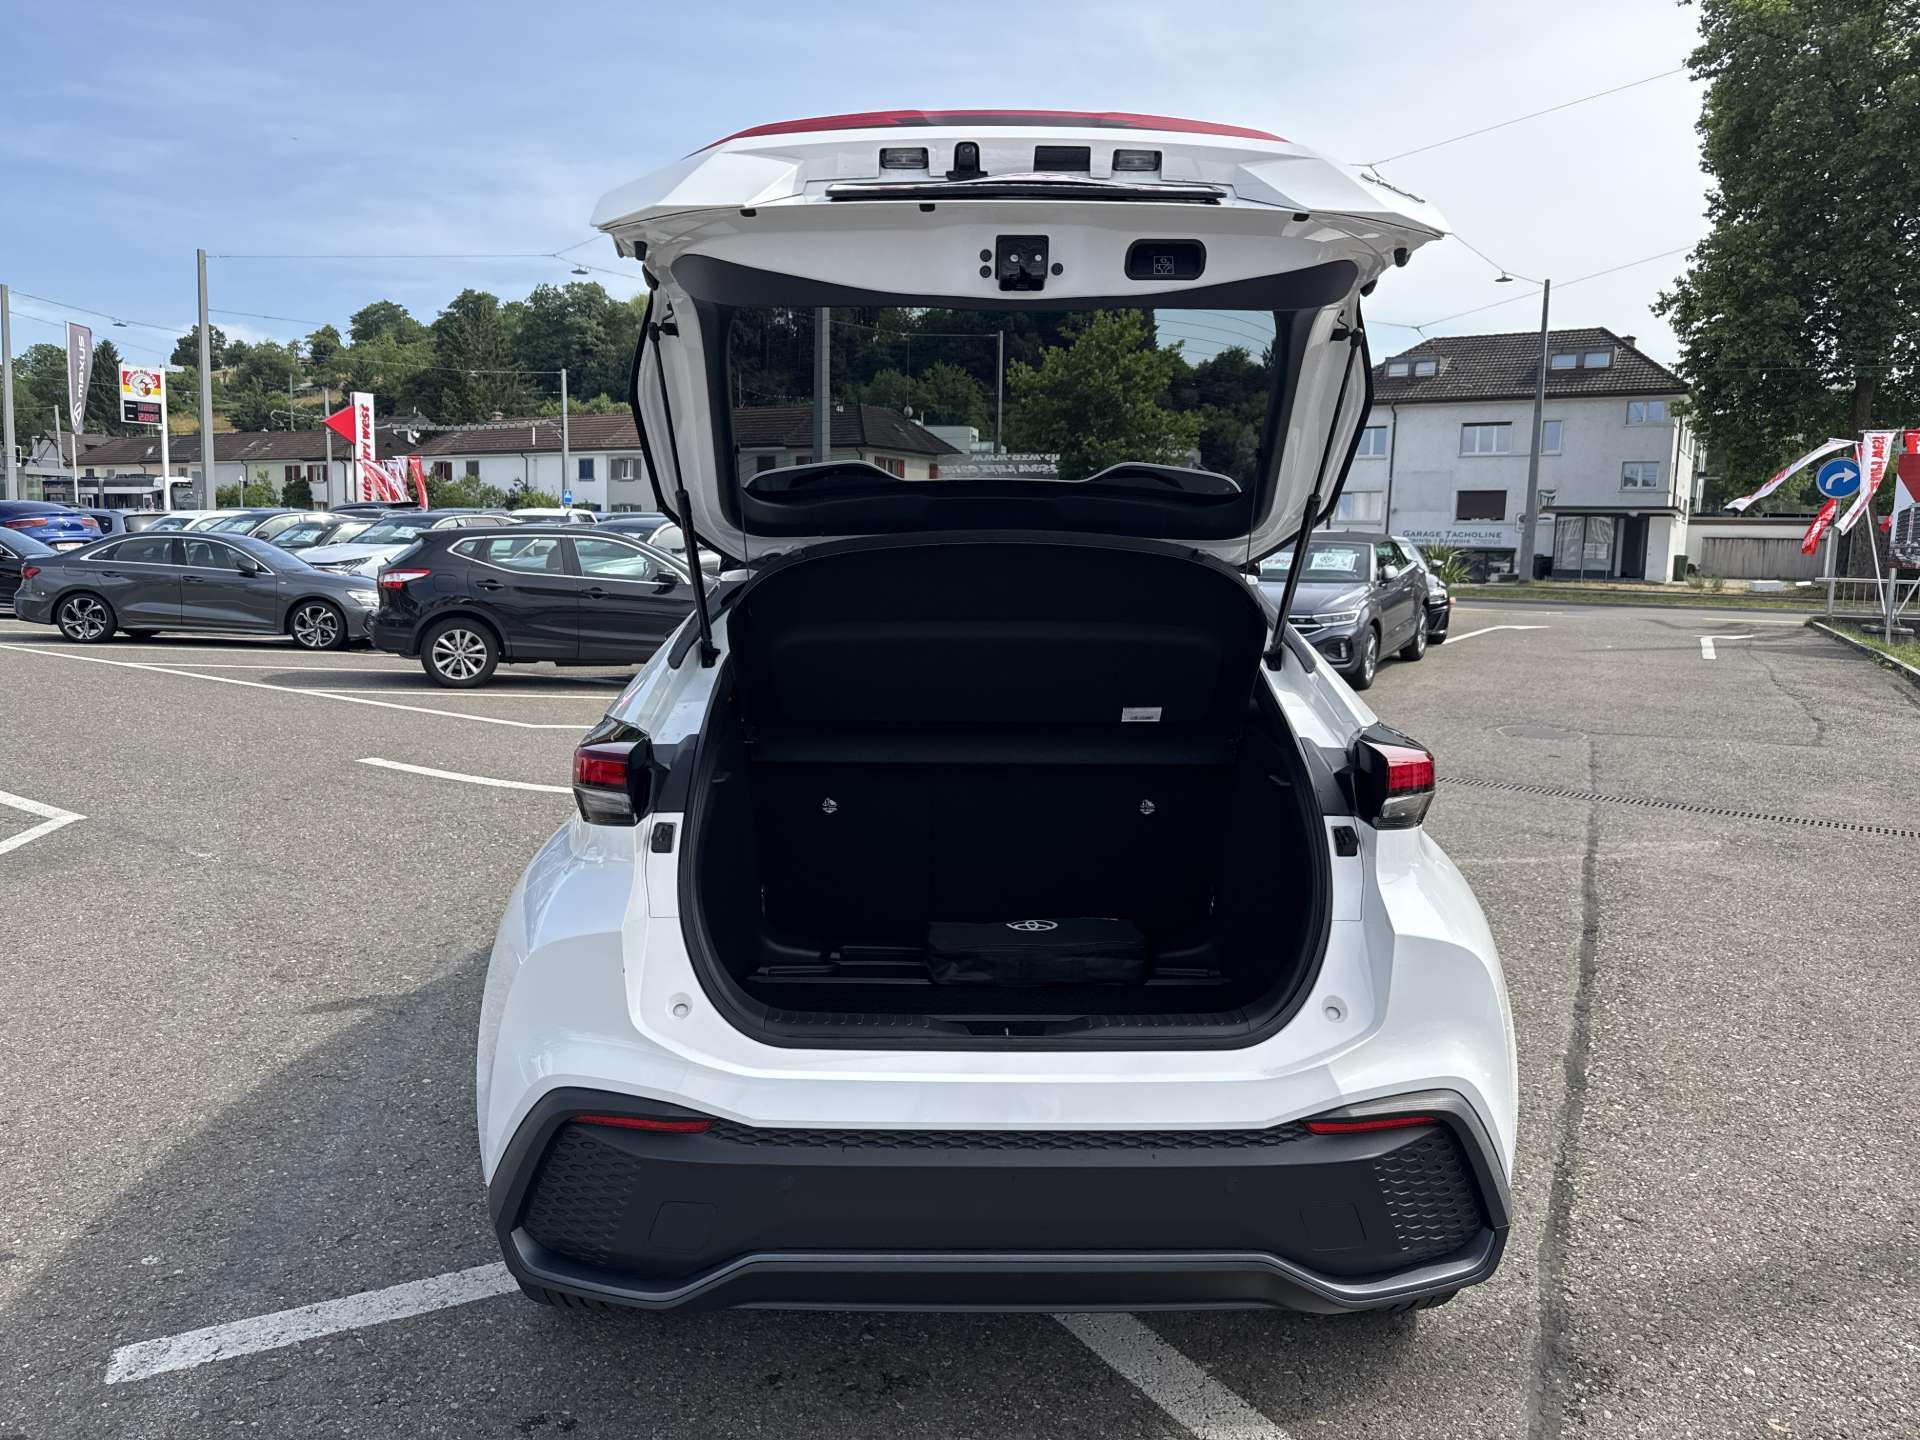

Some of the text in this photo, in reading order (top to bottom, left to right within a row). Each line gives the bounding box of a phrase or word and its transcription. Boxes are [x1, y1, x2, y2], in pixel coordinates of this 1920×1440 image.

[360, 404, 371, 440] west
[1402, 530, 1503, 539] GARAGE TACHOLINE
